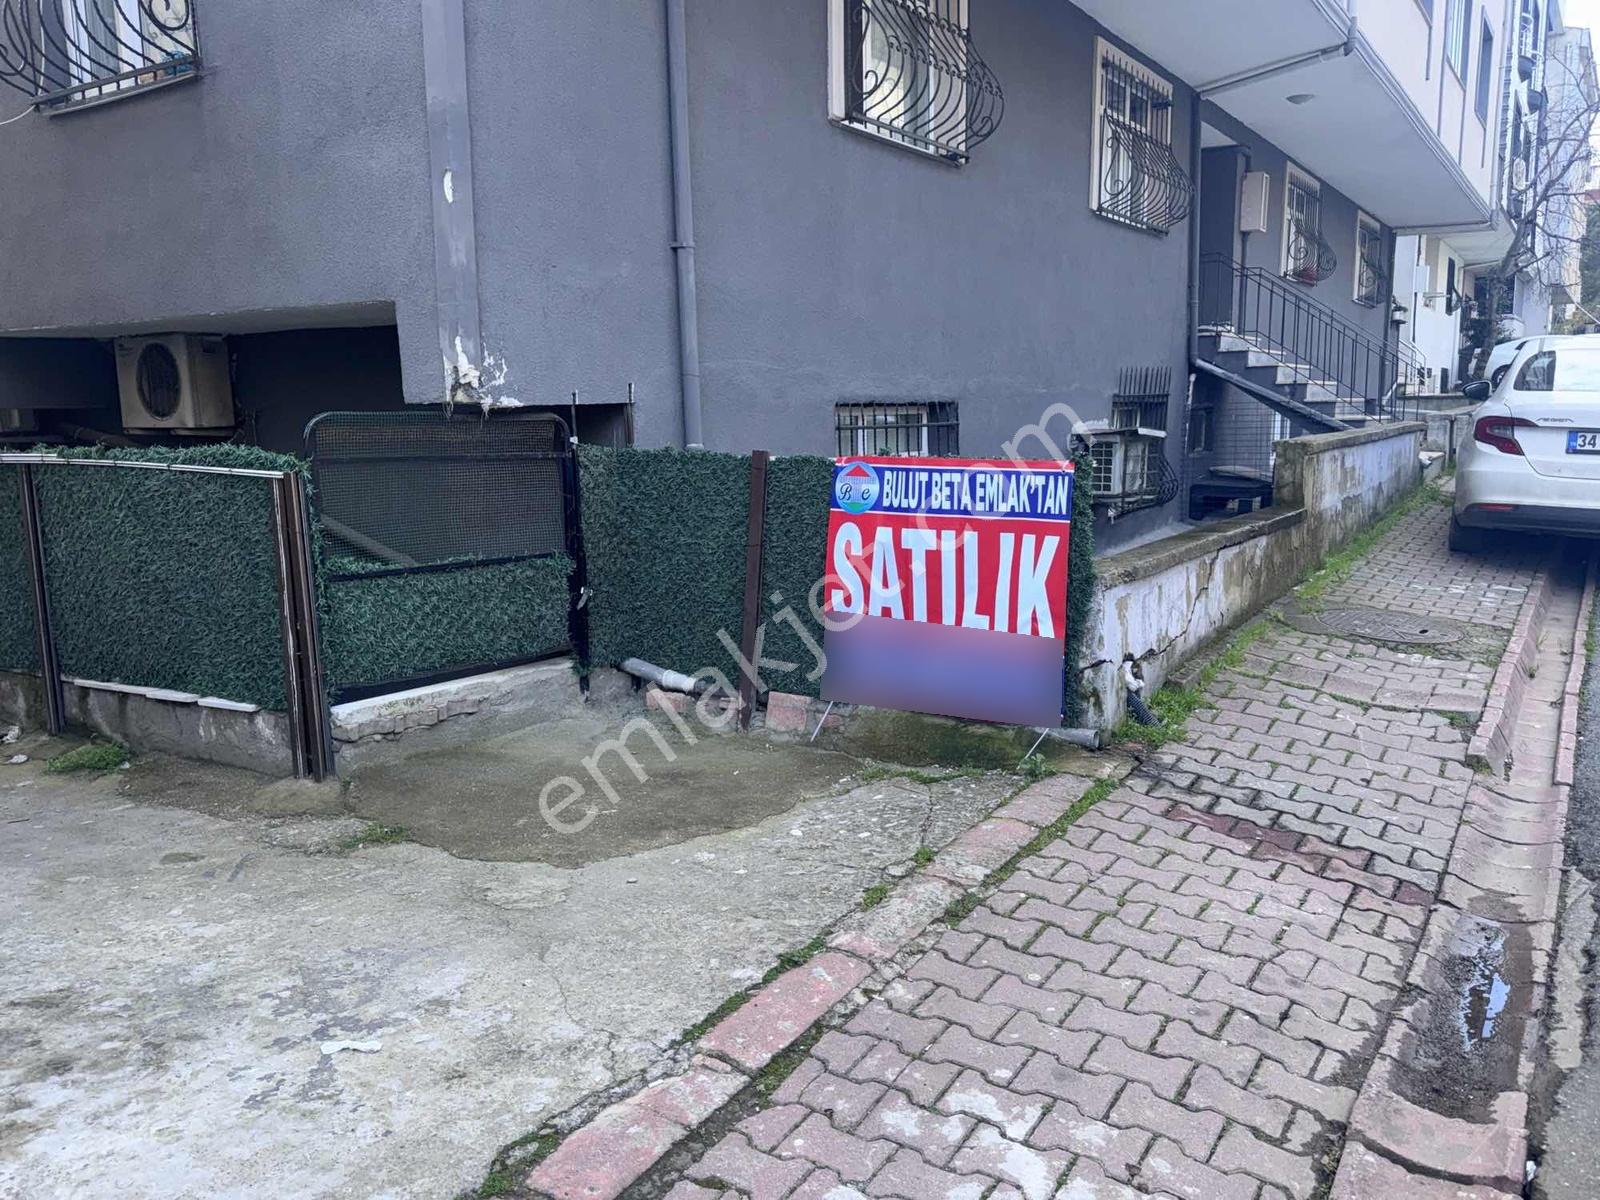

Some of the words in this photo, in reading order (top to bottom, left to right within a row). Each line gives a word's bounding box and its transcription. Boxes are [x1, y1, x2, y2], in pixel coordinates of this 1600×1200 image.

[1577, 434, 1598, 449] 34
[882, 470, 929, 510] BULUT
[931, 472, 972, 512] BETA
[831, 522, 1060, 638] SATILIK
